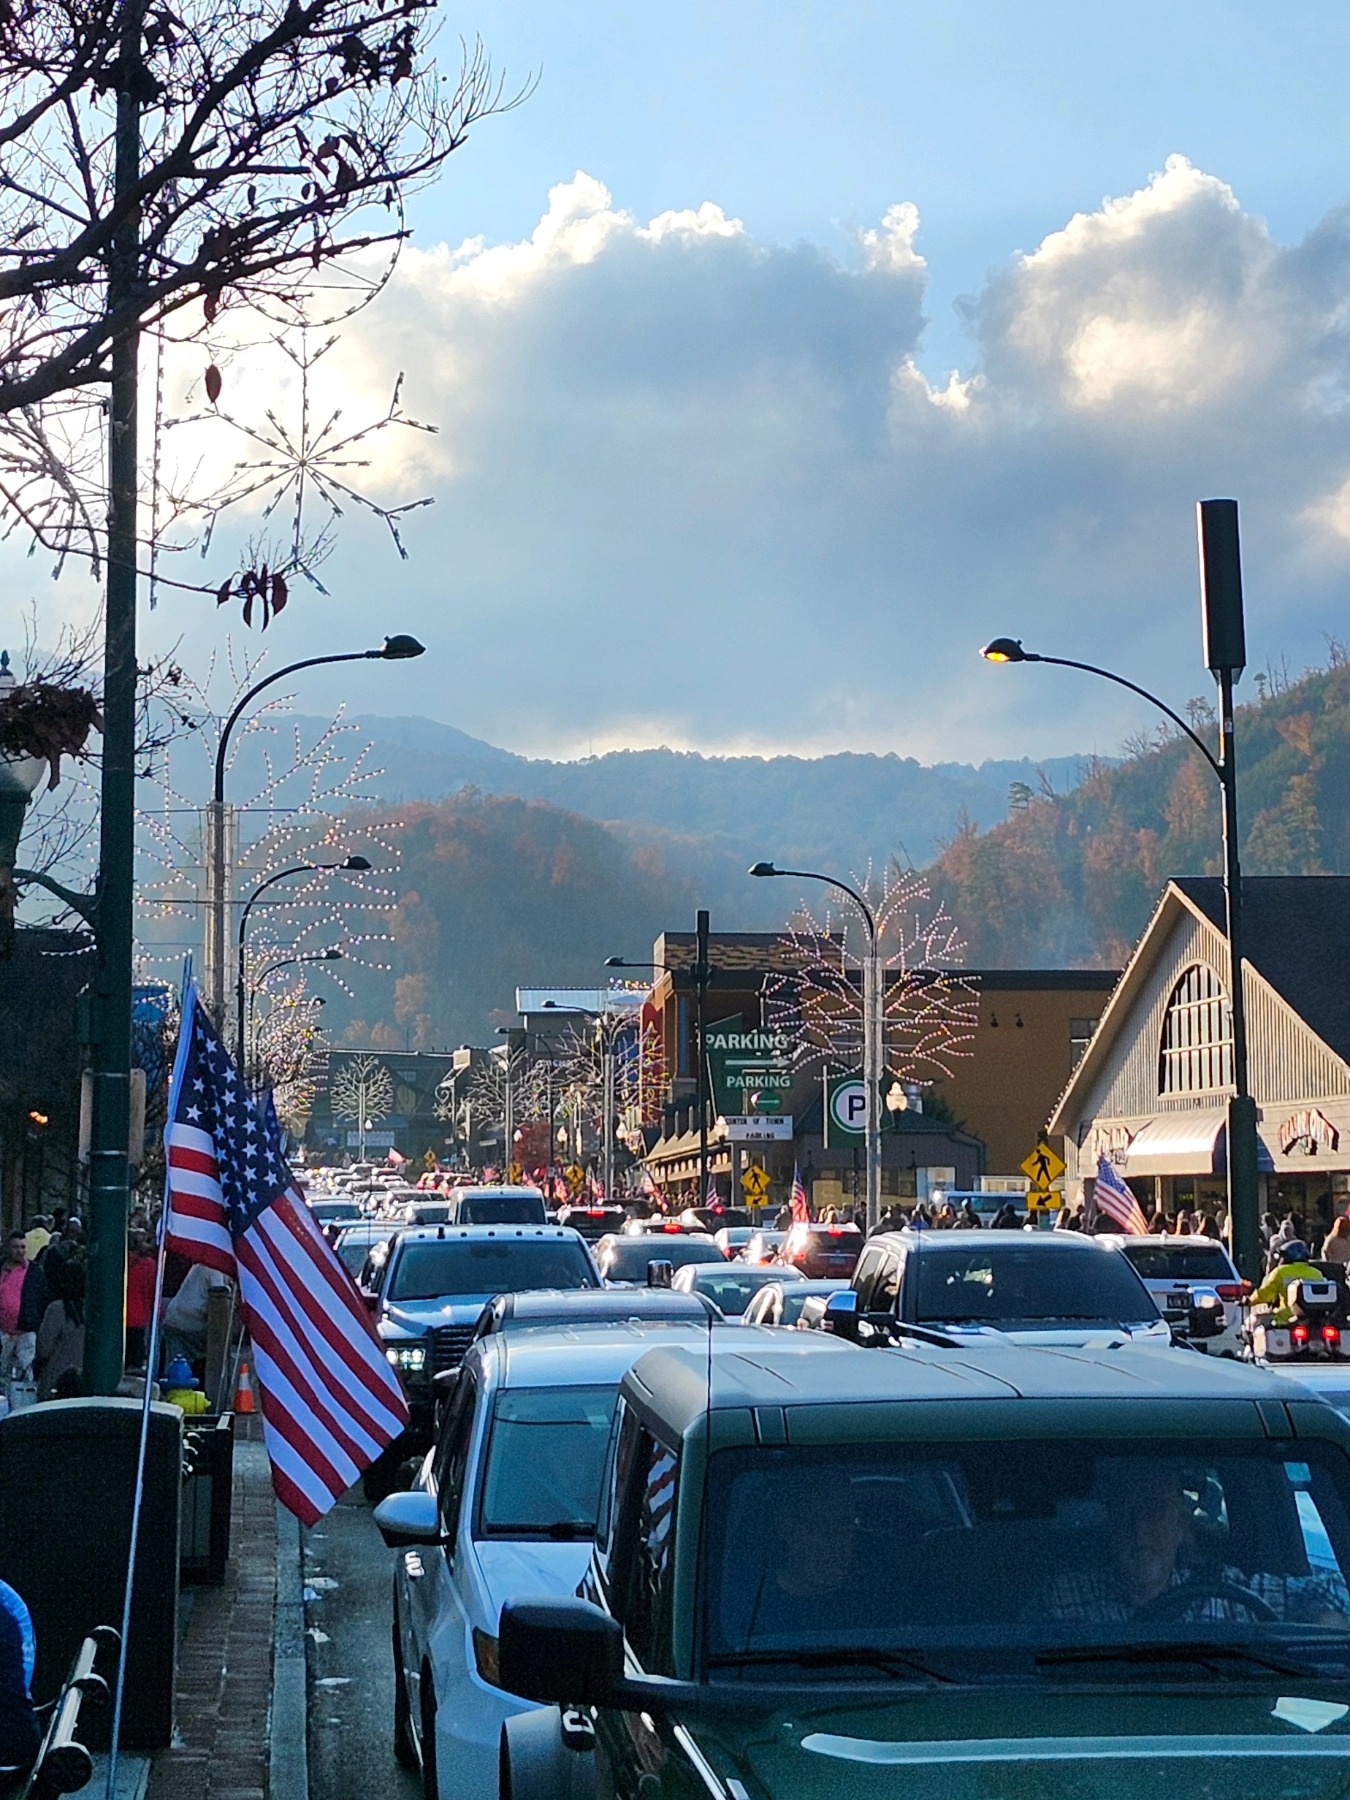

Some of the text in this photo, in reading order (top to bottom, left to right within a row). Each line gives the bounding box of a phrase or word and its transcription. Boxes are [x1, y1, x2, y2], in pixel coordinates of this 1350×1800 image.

[705, 1033, 788, 1049] PARKING
[726, 1075, 790, 1088] PARKING
[848, 1094, 866, 1121] P
